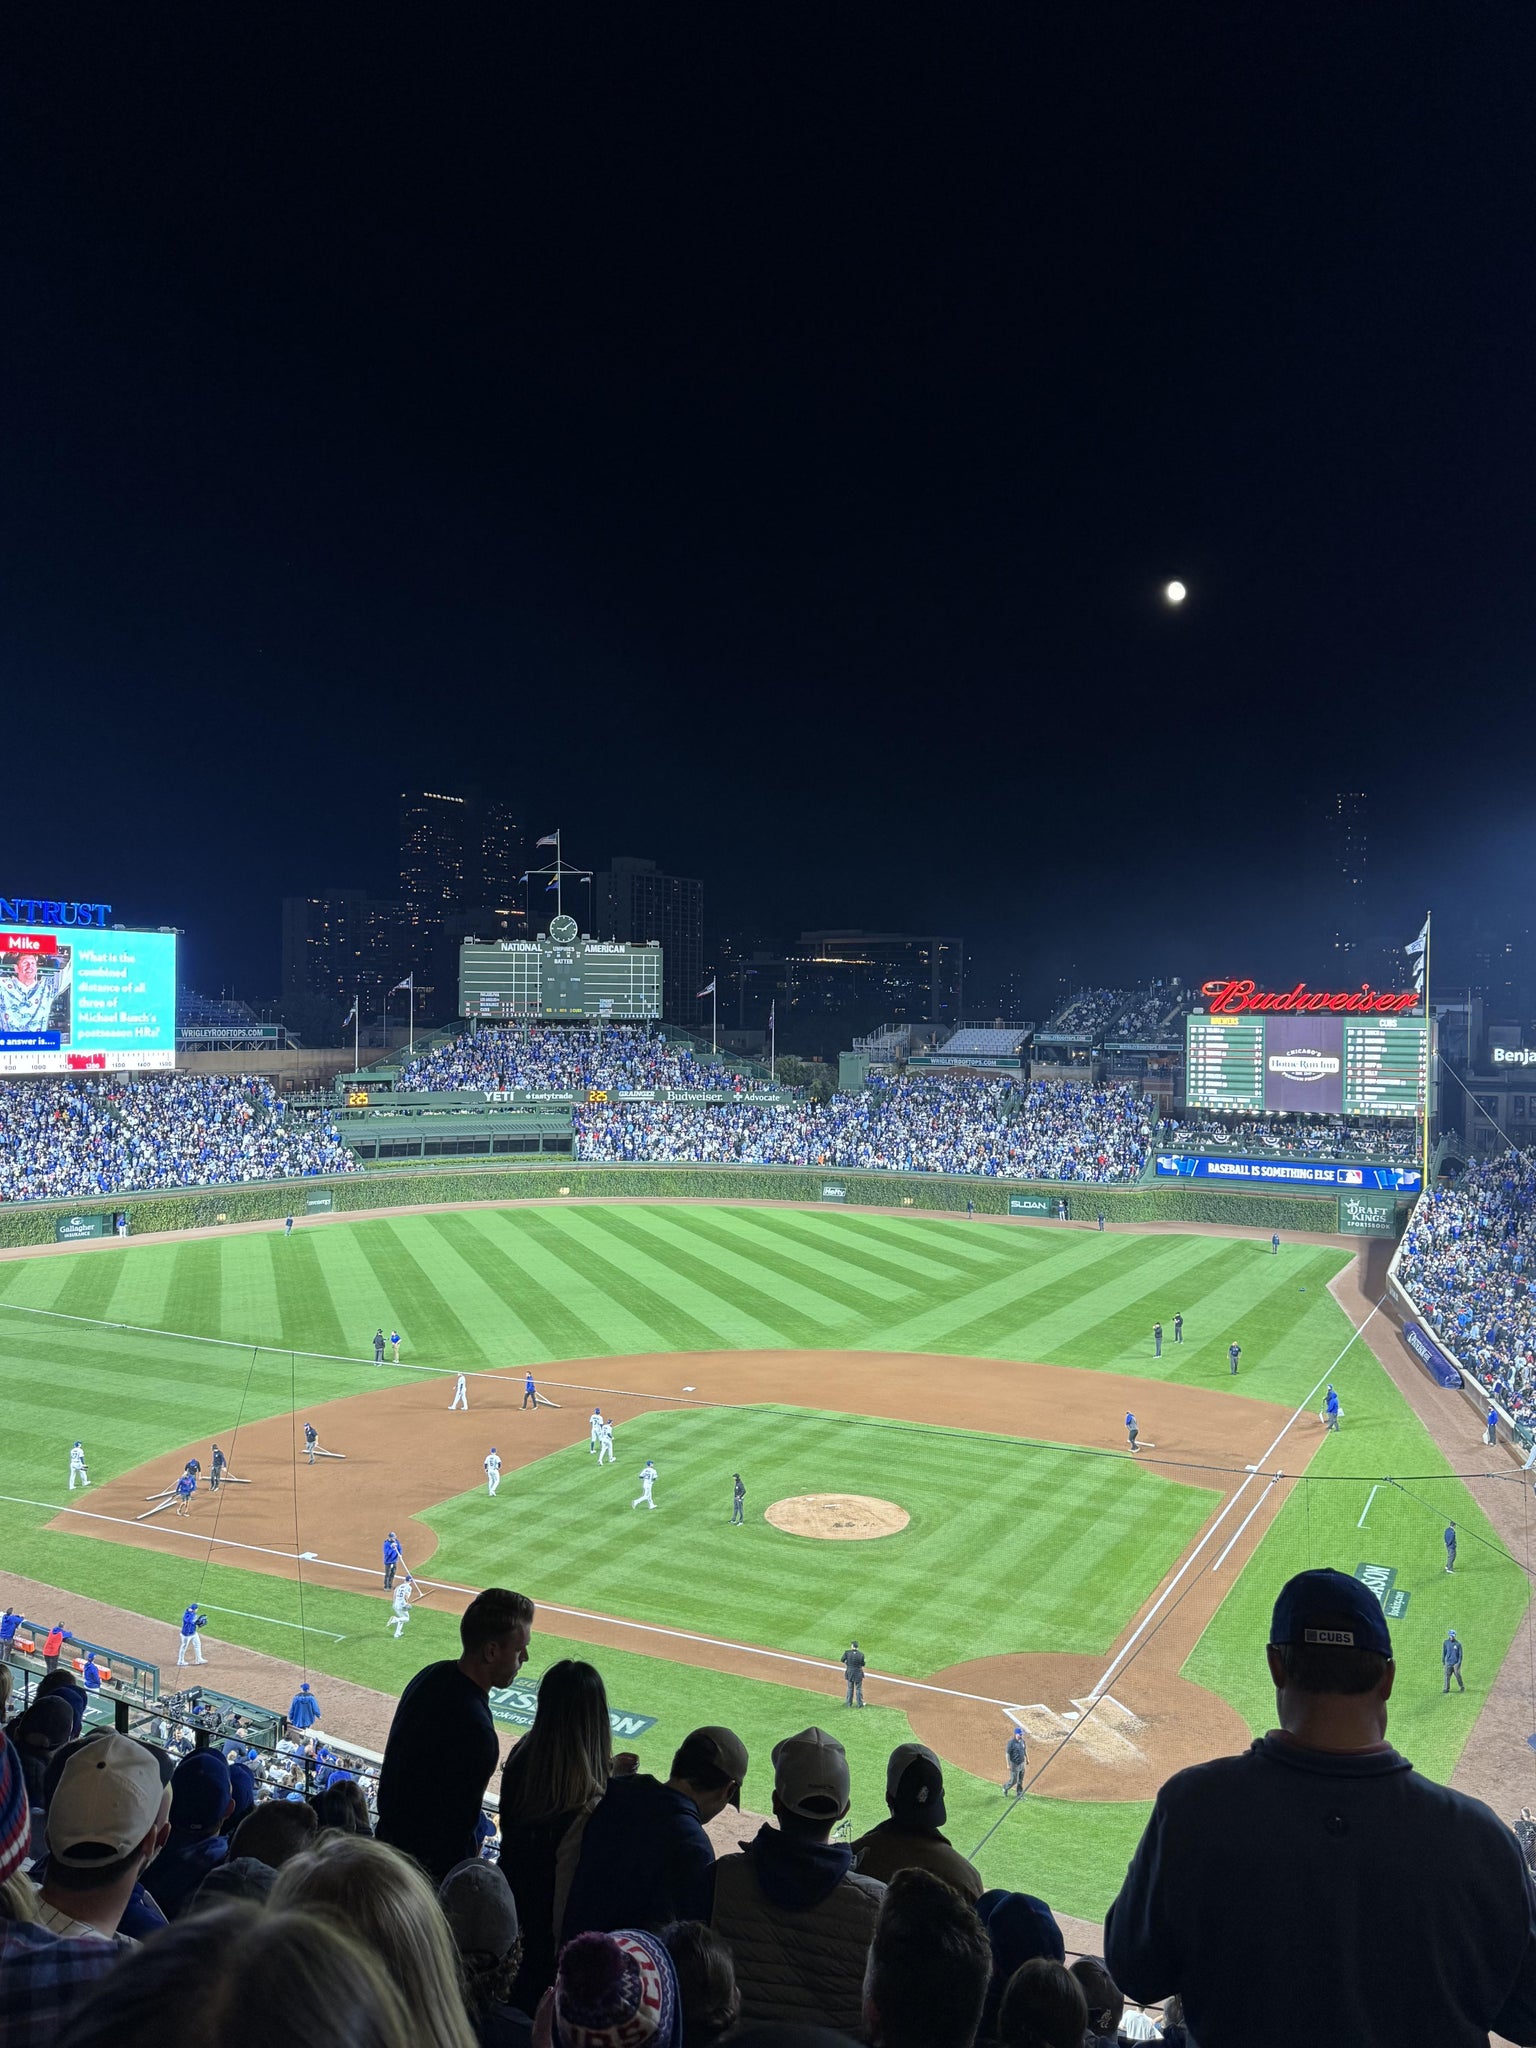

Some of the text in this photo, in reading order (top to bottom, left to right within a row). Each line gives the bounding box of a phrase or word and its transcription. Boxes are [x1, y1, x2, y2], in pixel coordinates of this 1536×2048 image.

[9, 936, 41, 951] Mike
[501, 943, 543, 952] NATIONAL
[584, 945, 625, 953] AMERICAN
[78, 950, 107, 963] What
[119, 951, 136, 963] the
[78, 967, 127, 978] combined
[78, 982, 146, 993] distance of all
[1201, 980, 1420, 1014] Budweiser
[78, 996, 118, 1008] three of
[78, 1012, 118, 1023] Michael
[1379, 1019, 1398, 1027] CUBS
[181, 1029, 263, 1037] WRIGLEYROOFTOPS.COM
[6, 1037, 37, 1045] answer
[1286, 1048, 1322, 1057] CHICAGO'S
[930, 1057, 997, 1066] WRIGLEYROOFTOPS.COM
[484, 1091, 515, 1101] YETI
[531, 1092, 573, 1101] tastytrade
[744, 1093, 781, 1101] Advocate
[1208, 1162, 1335, 1180] BASEBALL IS SOMETHING ELSE
[824, 1187, 845, 1196] Hefty
[1011, 1200, 1047, 1209] SLOAN
[1347, 1206, 1388, 1216] DRAFT
[1352, 1213, 1386, 1222] KINGS
[60, 1223, 95, 1233] Gallagher
[1347, 1221, 1390, 1229] SPORTSBOOK
[1319, 1632, 1351, 1643] CUBS
